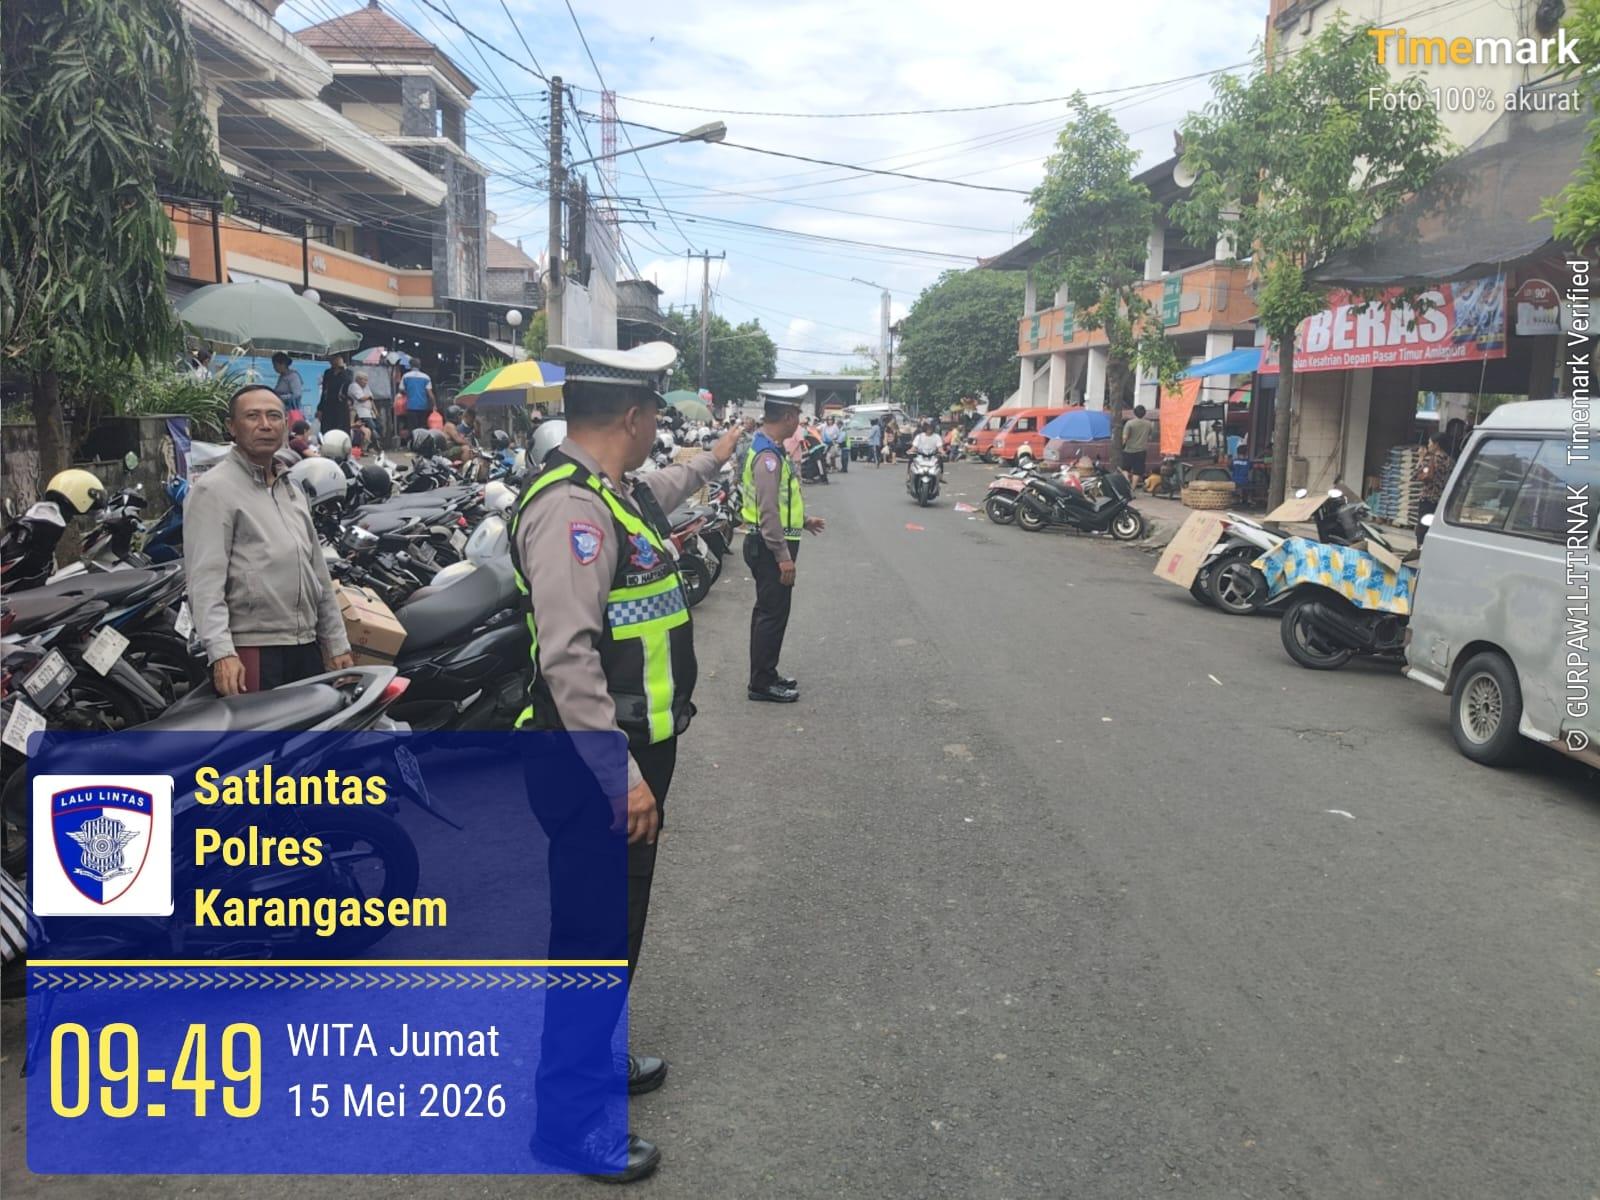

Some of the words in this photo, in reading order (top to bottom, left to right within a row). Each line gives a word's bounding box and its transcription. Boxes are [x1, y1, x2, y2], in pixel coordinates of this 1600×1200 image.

[1307, 291, 1448, 352] BERAS
[1343, 352, 1370, 367] Depan
[1372, 350, 1396, 363] Pasar
[1399, 347, 1423, 361] Timur
